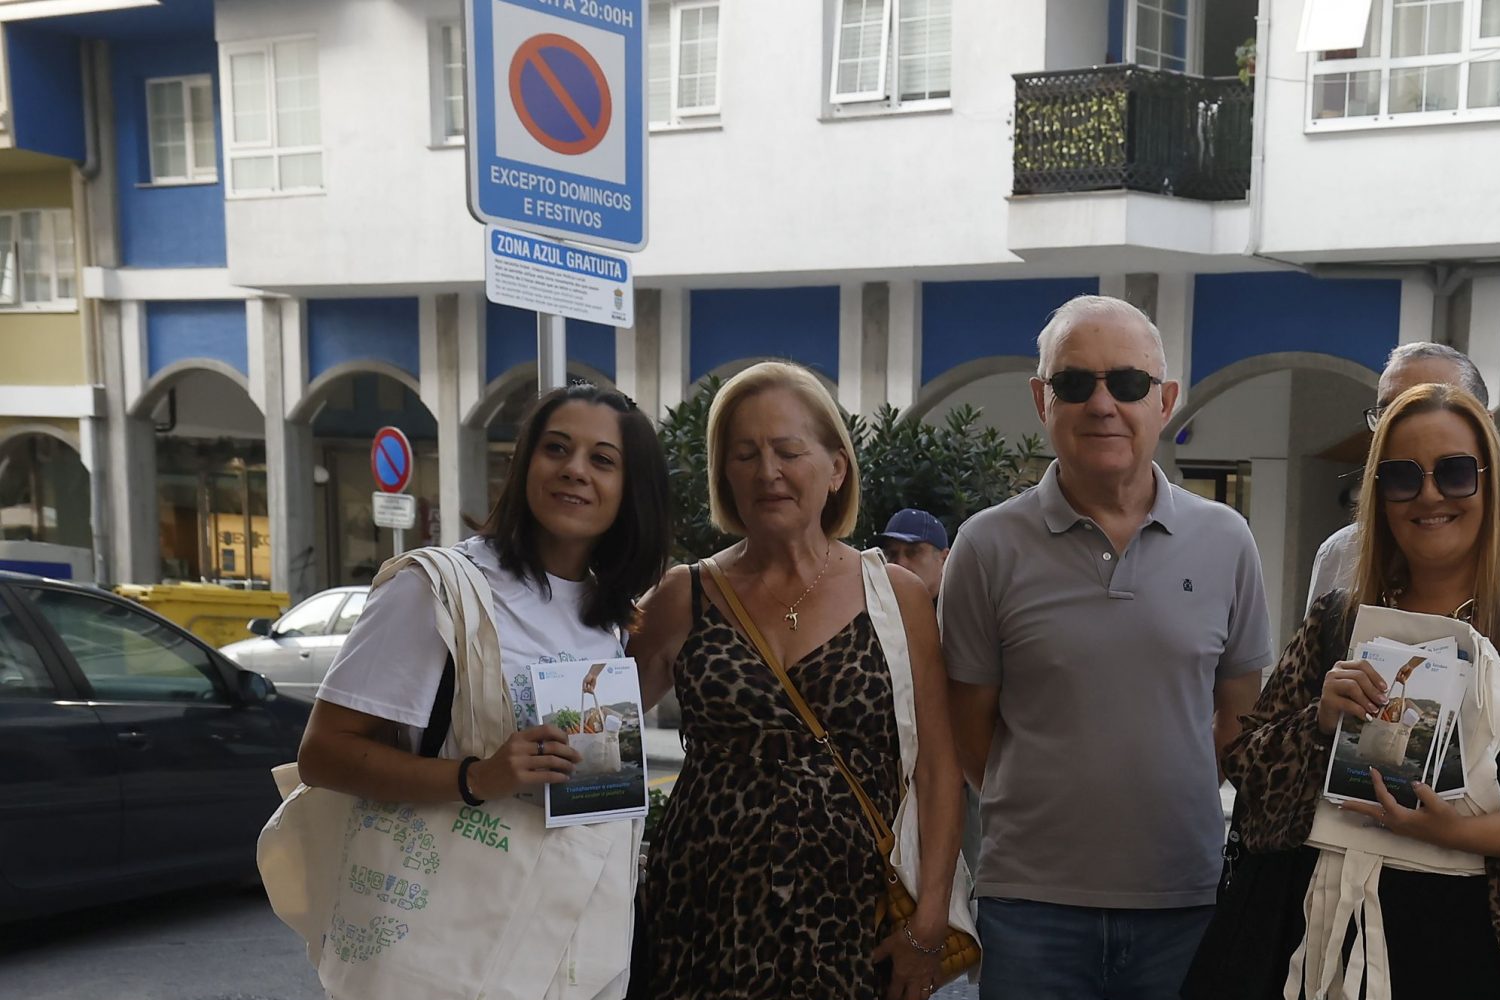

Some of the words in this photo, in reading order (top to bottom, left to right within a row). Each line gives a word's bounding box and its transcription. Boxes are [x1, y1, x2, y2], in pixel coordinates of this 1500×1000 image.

[580, 0, 633, 28] 20:00H
[490, 165, 557, 195] EXCEPTO
[560, 180, 632, 212] DOMINGOS
[524, 197, 533, 216] E
[537, 200, 602, 229] FESTIVOS
[497, 235, 530, 258] ZONA
[533, 243, 563, 266] AZUL
[566, 251, 622, 279] GRATUITA
[452, 819, 509, 853] PENSA
